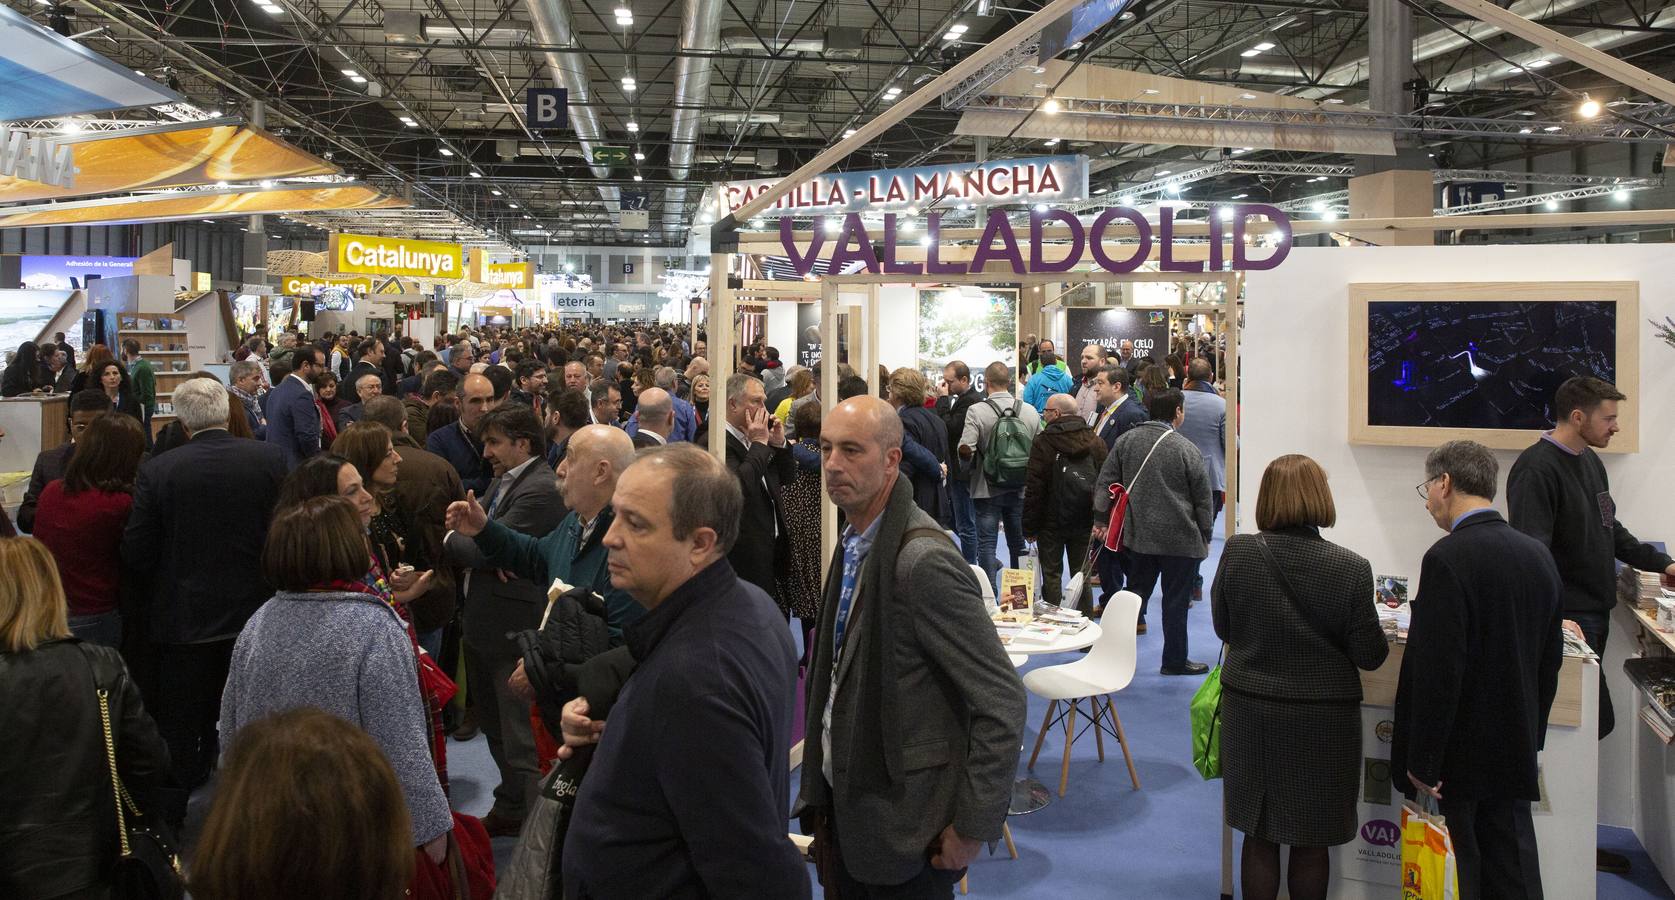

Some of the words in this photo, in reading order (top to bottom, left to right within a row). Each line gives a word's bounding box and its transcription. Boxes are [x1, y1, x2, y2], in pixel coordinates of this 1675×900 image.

[537, 94, 558, 122] B
[869, 176, 906, 203] LA
[914, 164, 1061, 201] MANCHA
[780, 202, 1293, 276] VALLADOLID
[346, 241, 454, 275] Catalunya
[625, 264, 632, 273] B
[1134, 339, 1154, 350] CIELO
